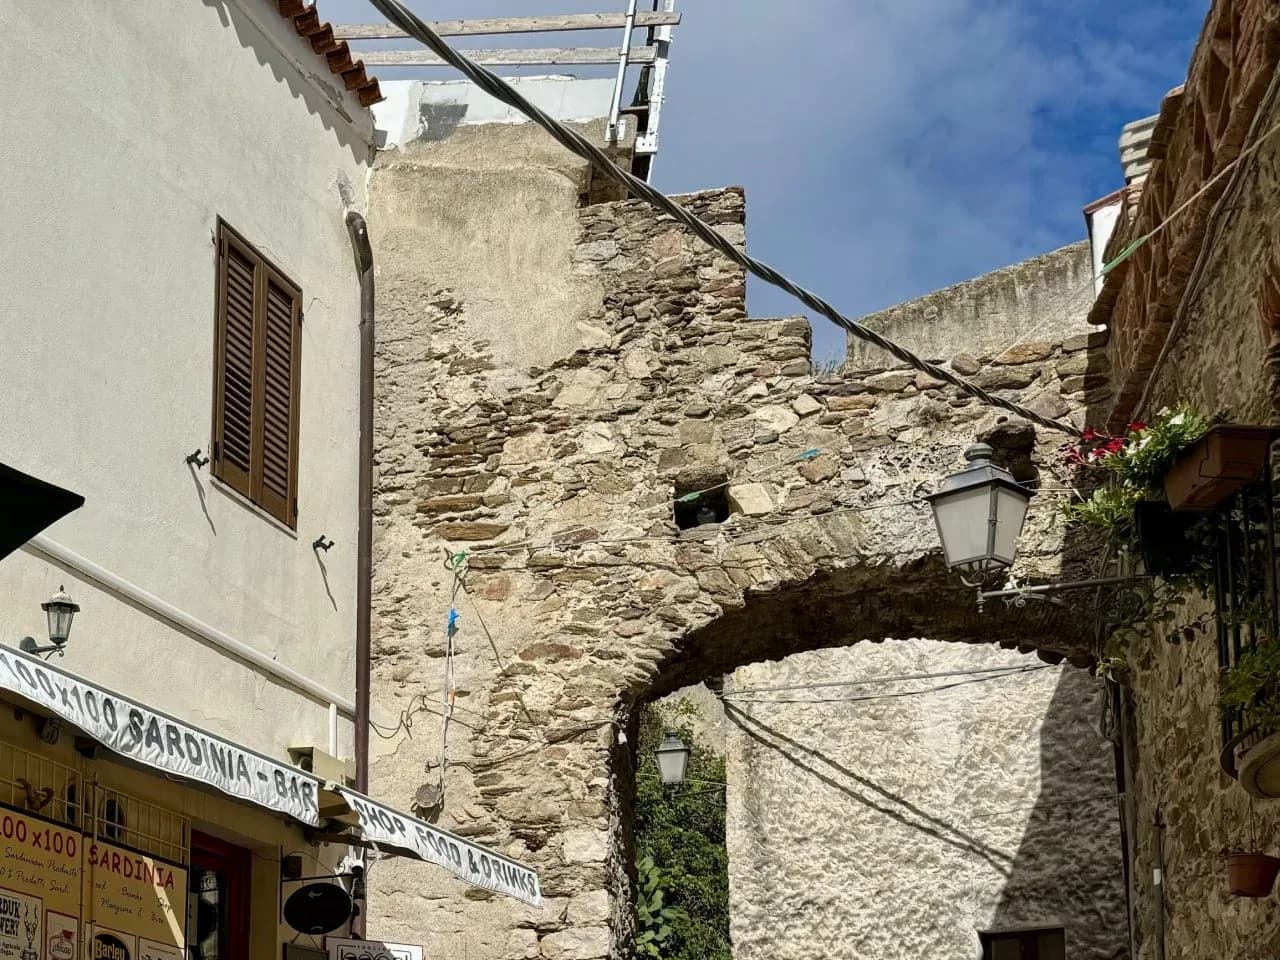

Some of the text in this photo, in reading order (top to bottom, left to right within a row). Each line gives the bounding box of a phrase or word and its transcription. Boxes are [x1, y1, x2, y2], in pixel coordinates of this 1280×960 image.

[128, 708, 253, 786] SARDINIA
[274, 768, 318, 809] BAR
[352, 799, 407, 838] SHOP
[87, 844, 176, 890] SARDINIA
